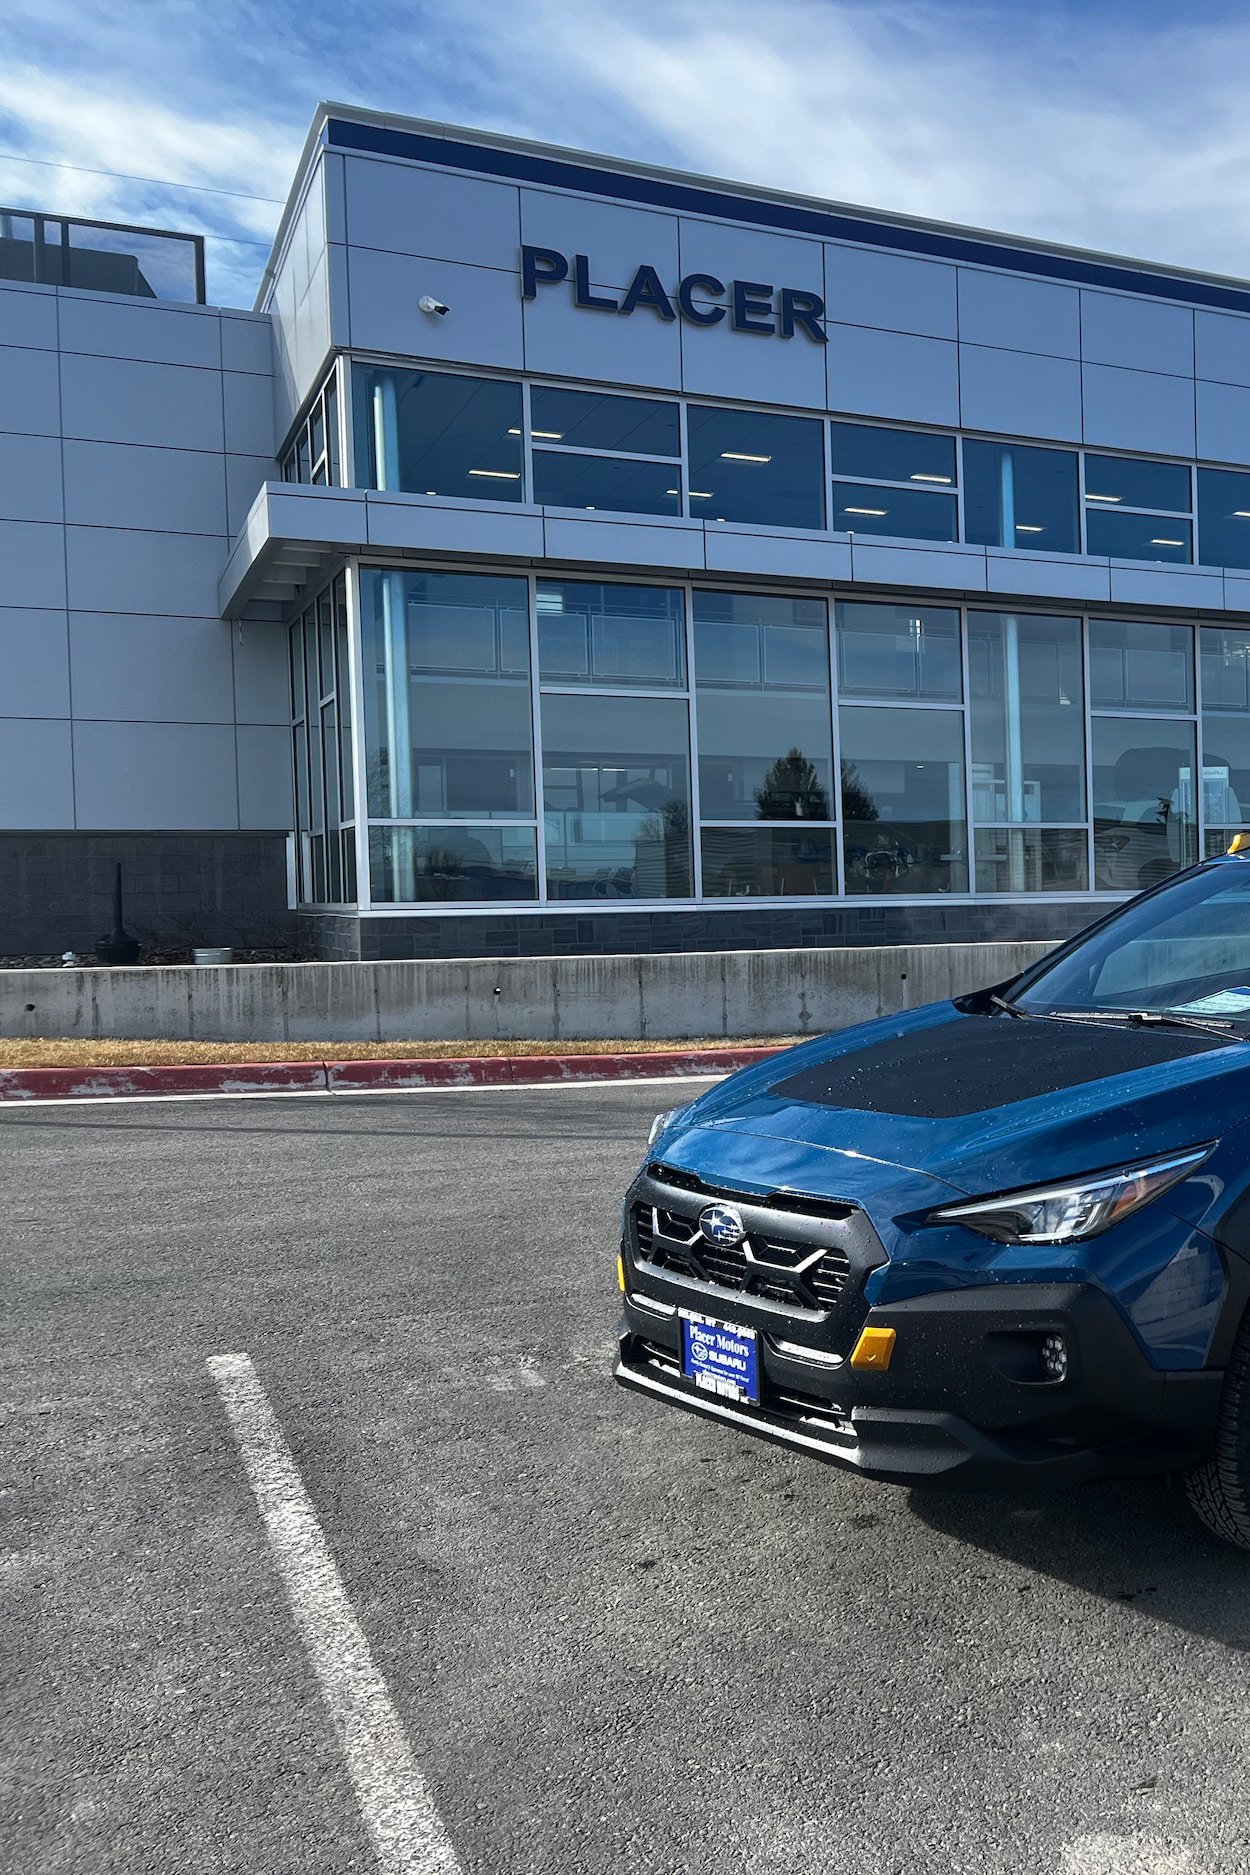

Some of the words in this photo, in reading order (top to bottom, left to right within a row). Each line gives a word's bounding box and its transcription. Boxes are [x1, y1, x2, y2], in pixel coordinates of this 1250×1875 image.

[521, 245, 829, 342] PLACER
[689, 1325, 716, 1346] Placer
[716, 1334, 749, 1357] Motors
[709, 1350, 746, 1371] SUBARU
